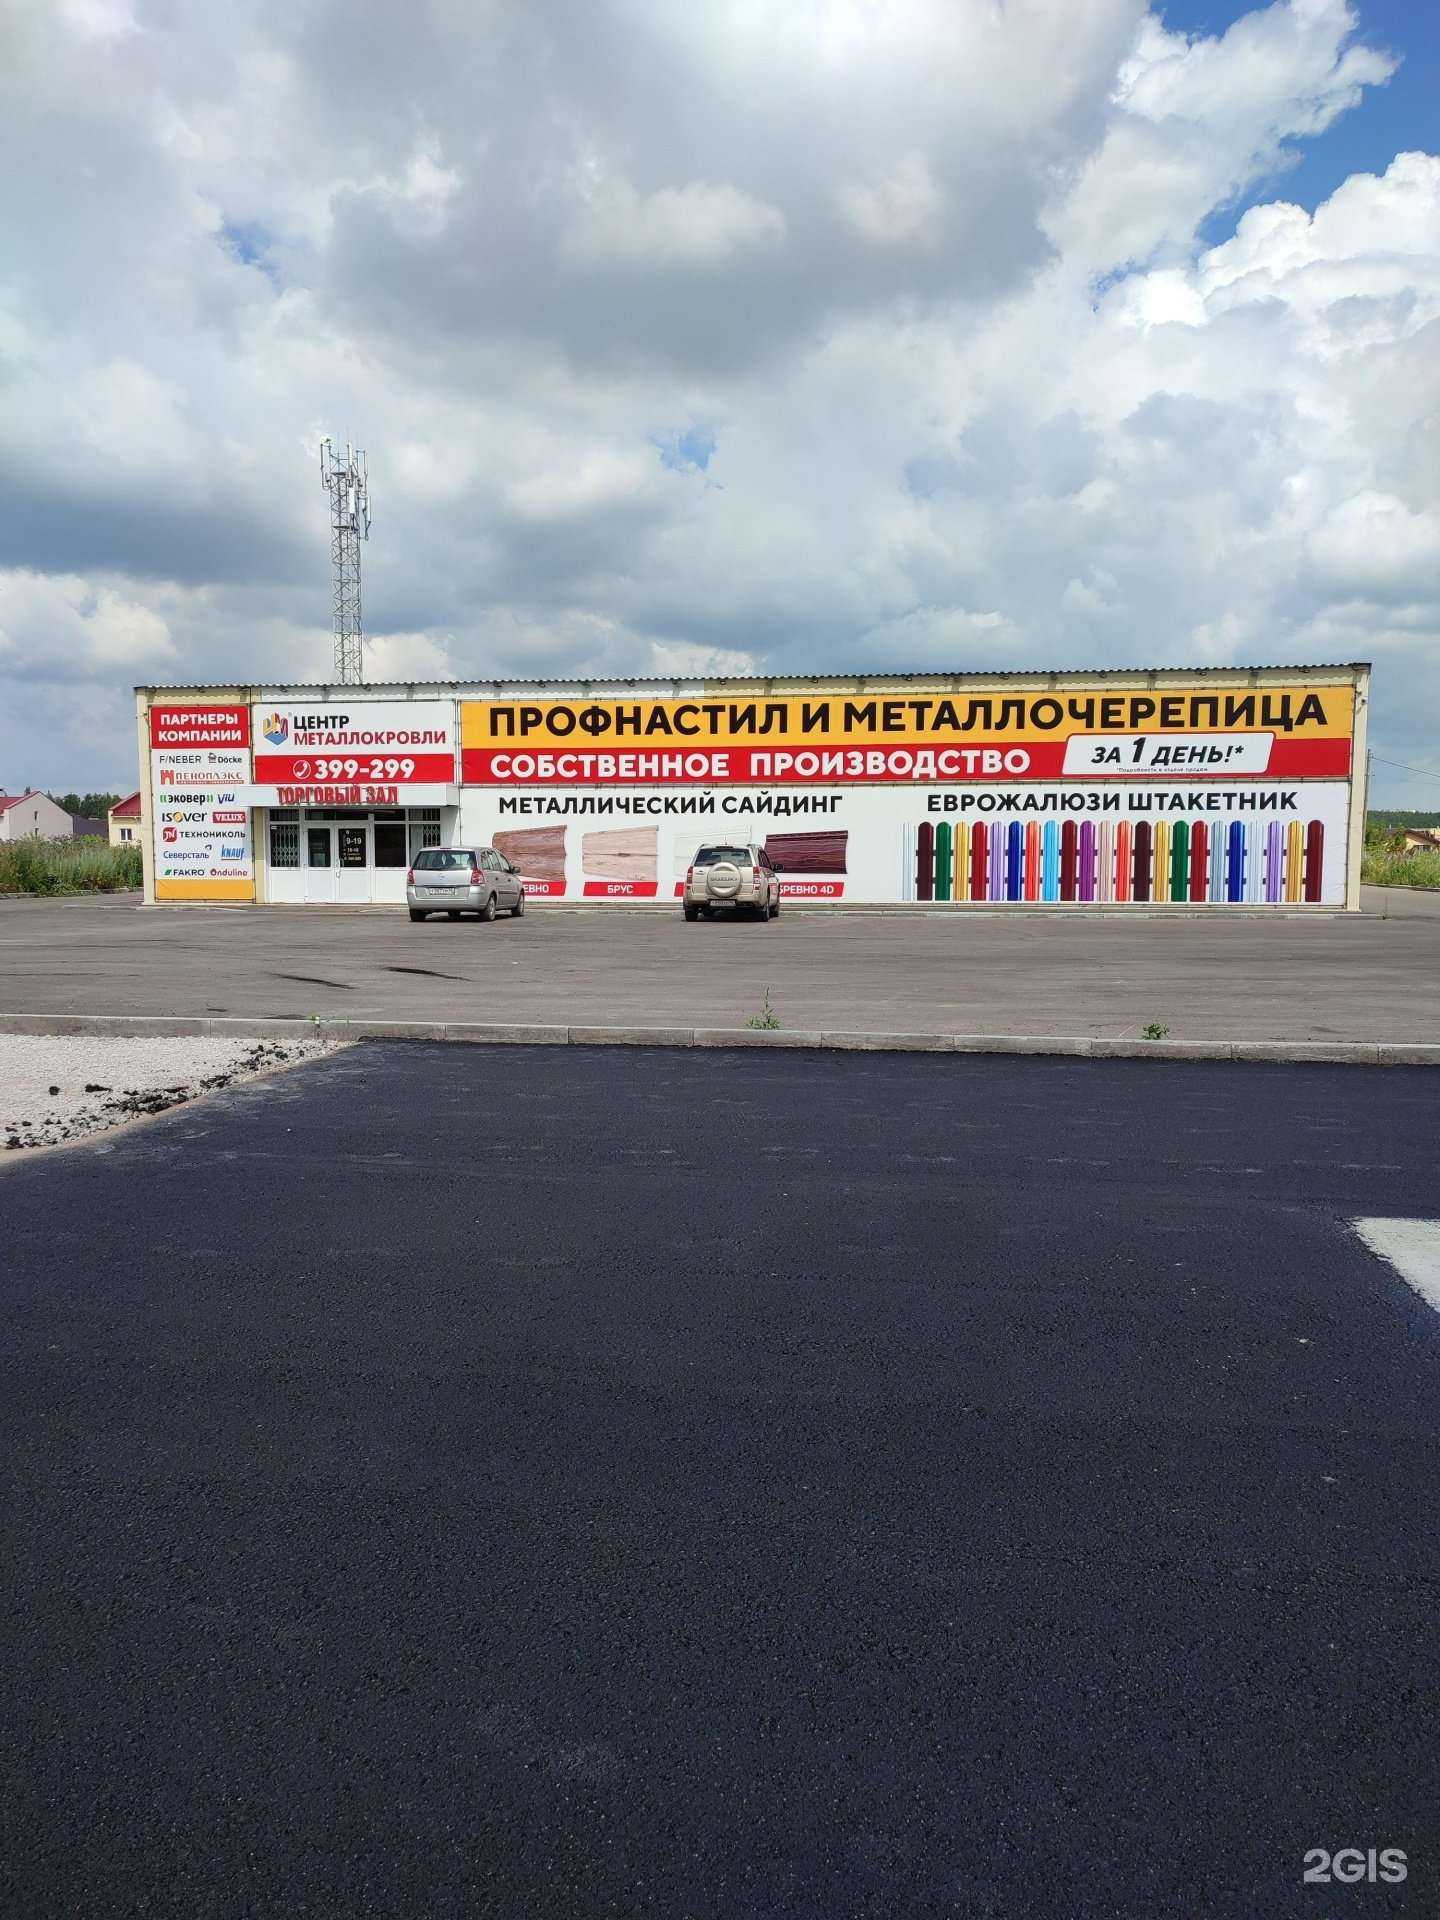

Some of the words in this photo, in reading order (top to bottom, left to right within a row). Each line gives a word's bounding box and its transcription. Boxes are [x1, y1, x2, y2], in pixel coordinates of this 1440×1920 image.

[160, 713, 238, 725] ПАРТНЕРЫ
[293, 715, 350, 731] ЦЕНТР
[489, 702, 788, 737] ПРОФНАСТИЛ
[802, 702, 830, 733] И
[843, 694, 1327, 732] МЕТАЛЛОЧЕРЕПИЦА
[158, 729, 241, 742] КОМПАНИИ
[293, 730, 446, 746] МЕТАЛЛОКРОВЛИ
[1091, 746, 1121, 764] ЗА
[1132, 737, 1147, 763] 1
[314, 758, 415, 780] 399-299
[490, 753, 729, 778] СОБСТВЕННОЕ
[750, 748, 1031, 778] ПРОИЗВОДСТВО
[276, 786, 362, 805] ТОРГОВЫЙ
[366, 786, 399, 804] ЗАЛ
[499, 792, 715, 814] МЕТАЛЛИЧЕСКИЙ
[721, 791, 843, 816] САЙДИНГ
[927, 793, 1121, 813] ЕВРОЖАЛЮЗИ
[1127, 791, 1299, 811] ШТАКЕТНИК
[163, 850, 210, 861] Северсталь
[173, 868, 206, 877] FAKRO
[607, 884, 633, 895] БРУС
